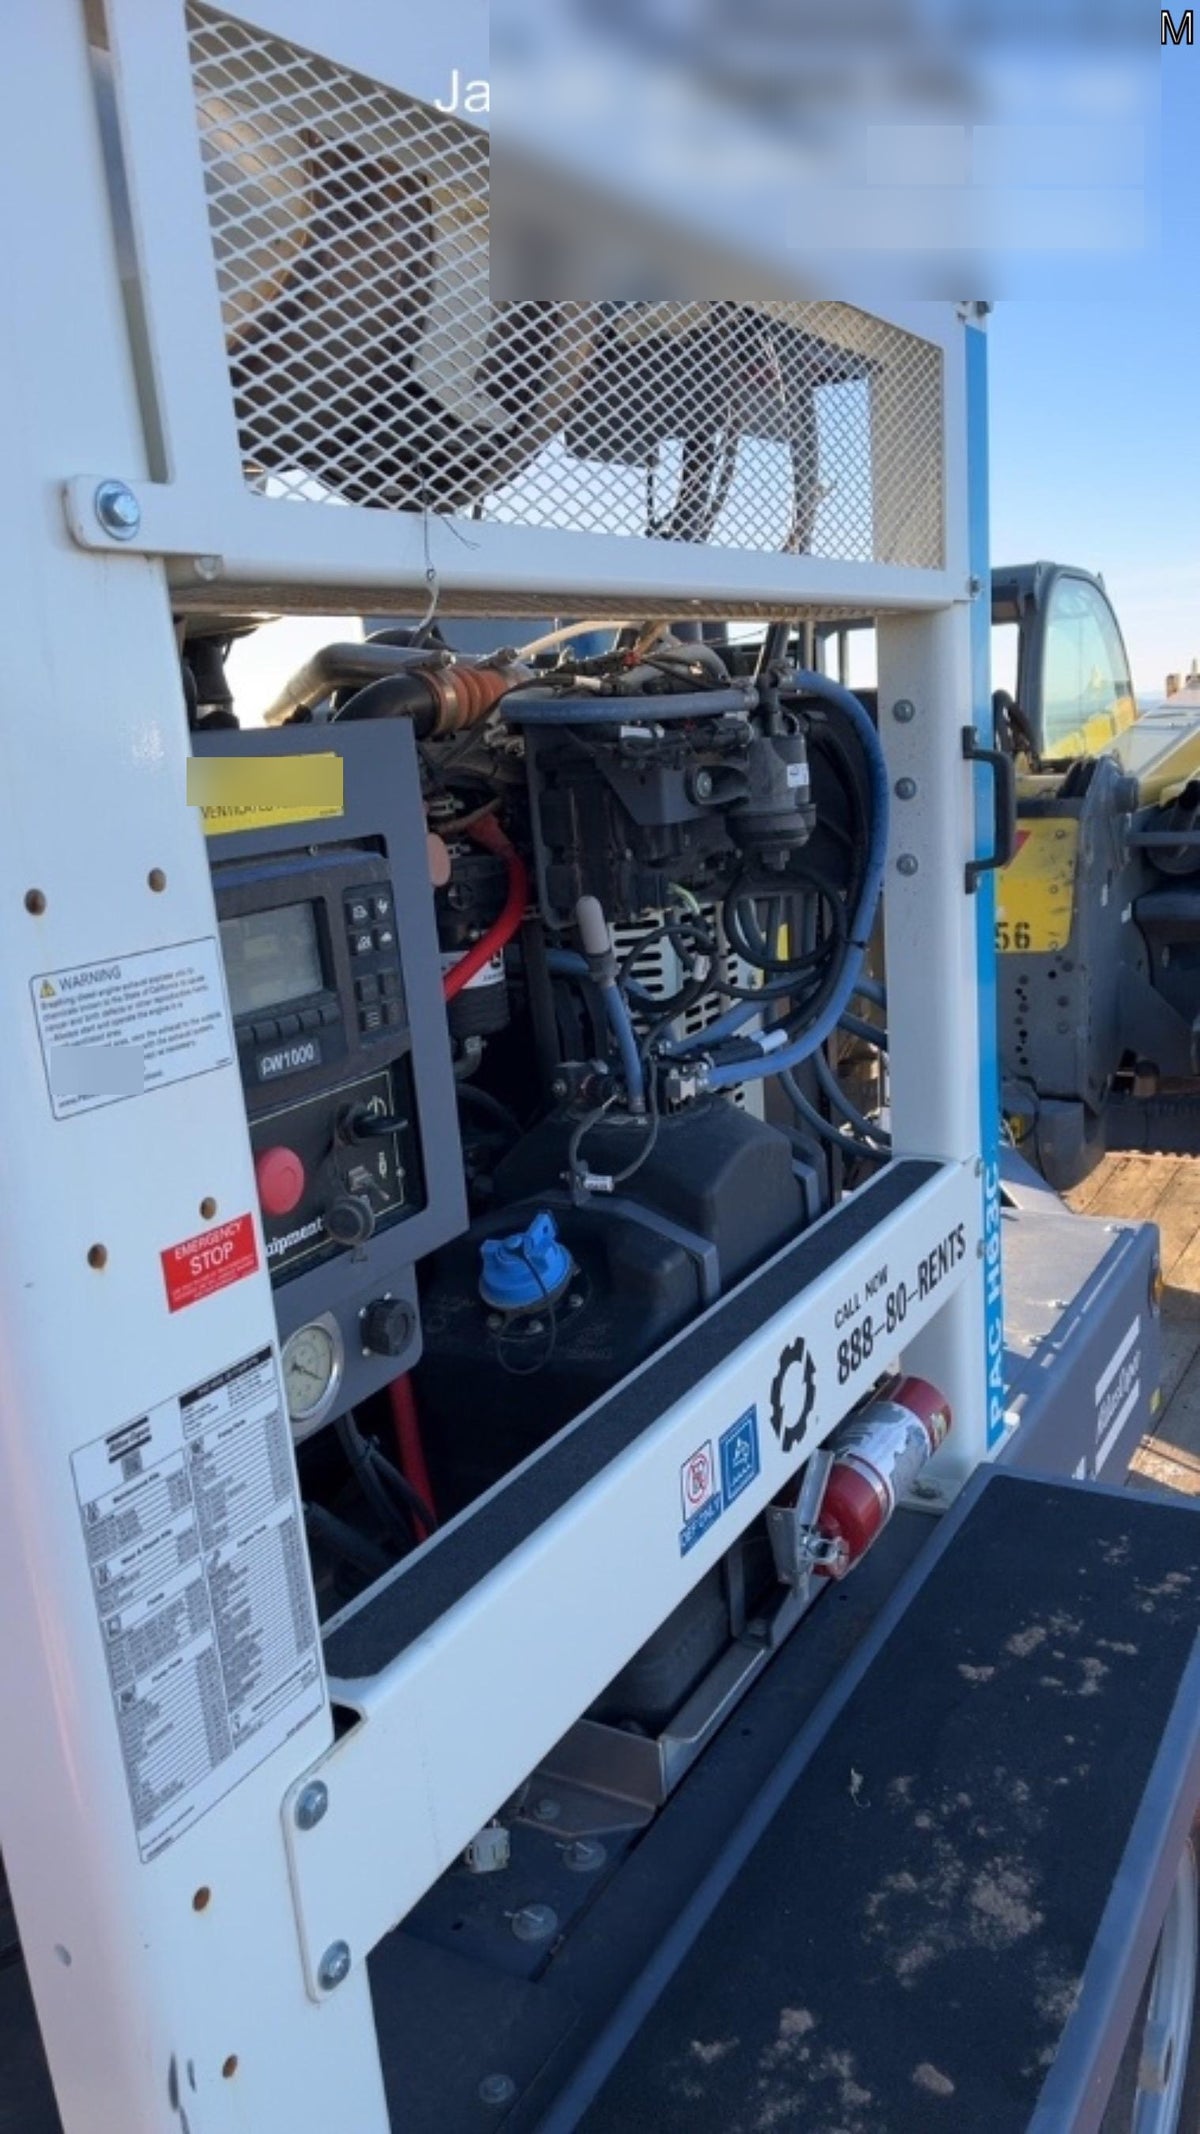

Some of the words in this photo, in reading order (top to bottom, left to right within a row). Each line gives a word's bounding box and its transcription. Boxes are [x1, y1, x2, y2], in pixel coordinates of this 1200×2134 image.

[58, 965, 121, 992] WARNING
[174, 1219, 242, 1261] EMERGENCY
[189, 1241, 234, 1275] STOP
[834, 1292, 861, 1329] CALL
[836, 1222, 967, 1386] 888-80-RENTS
